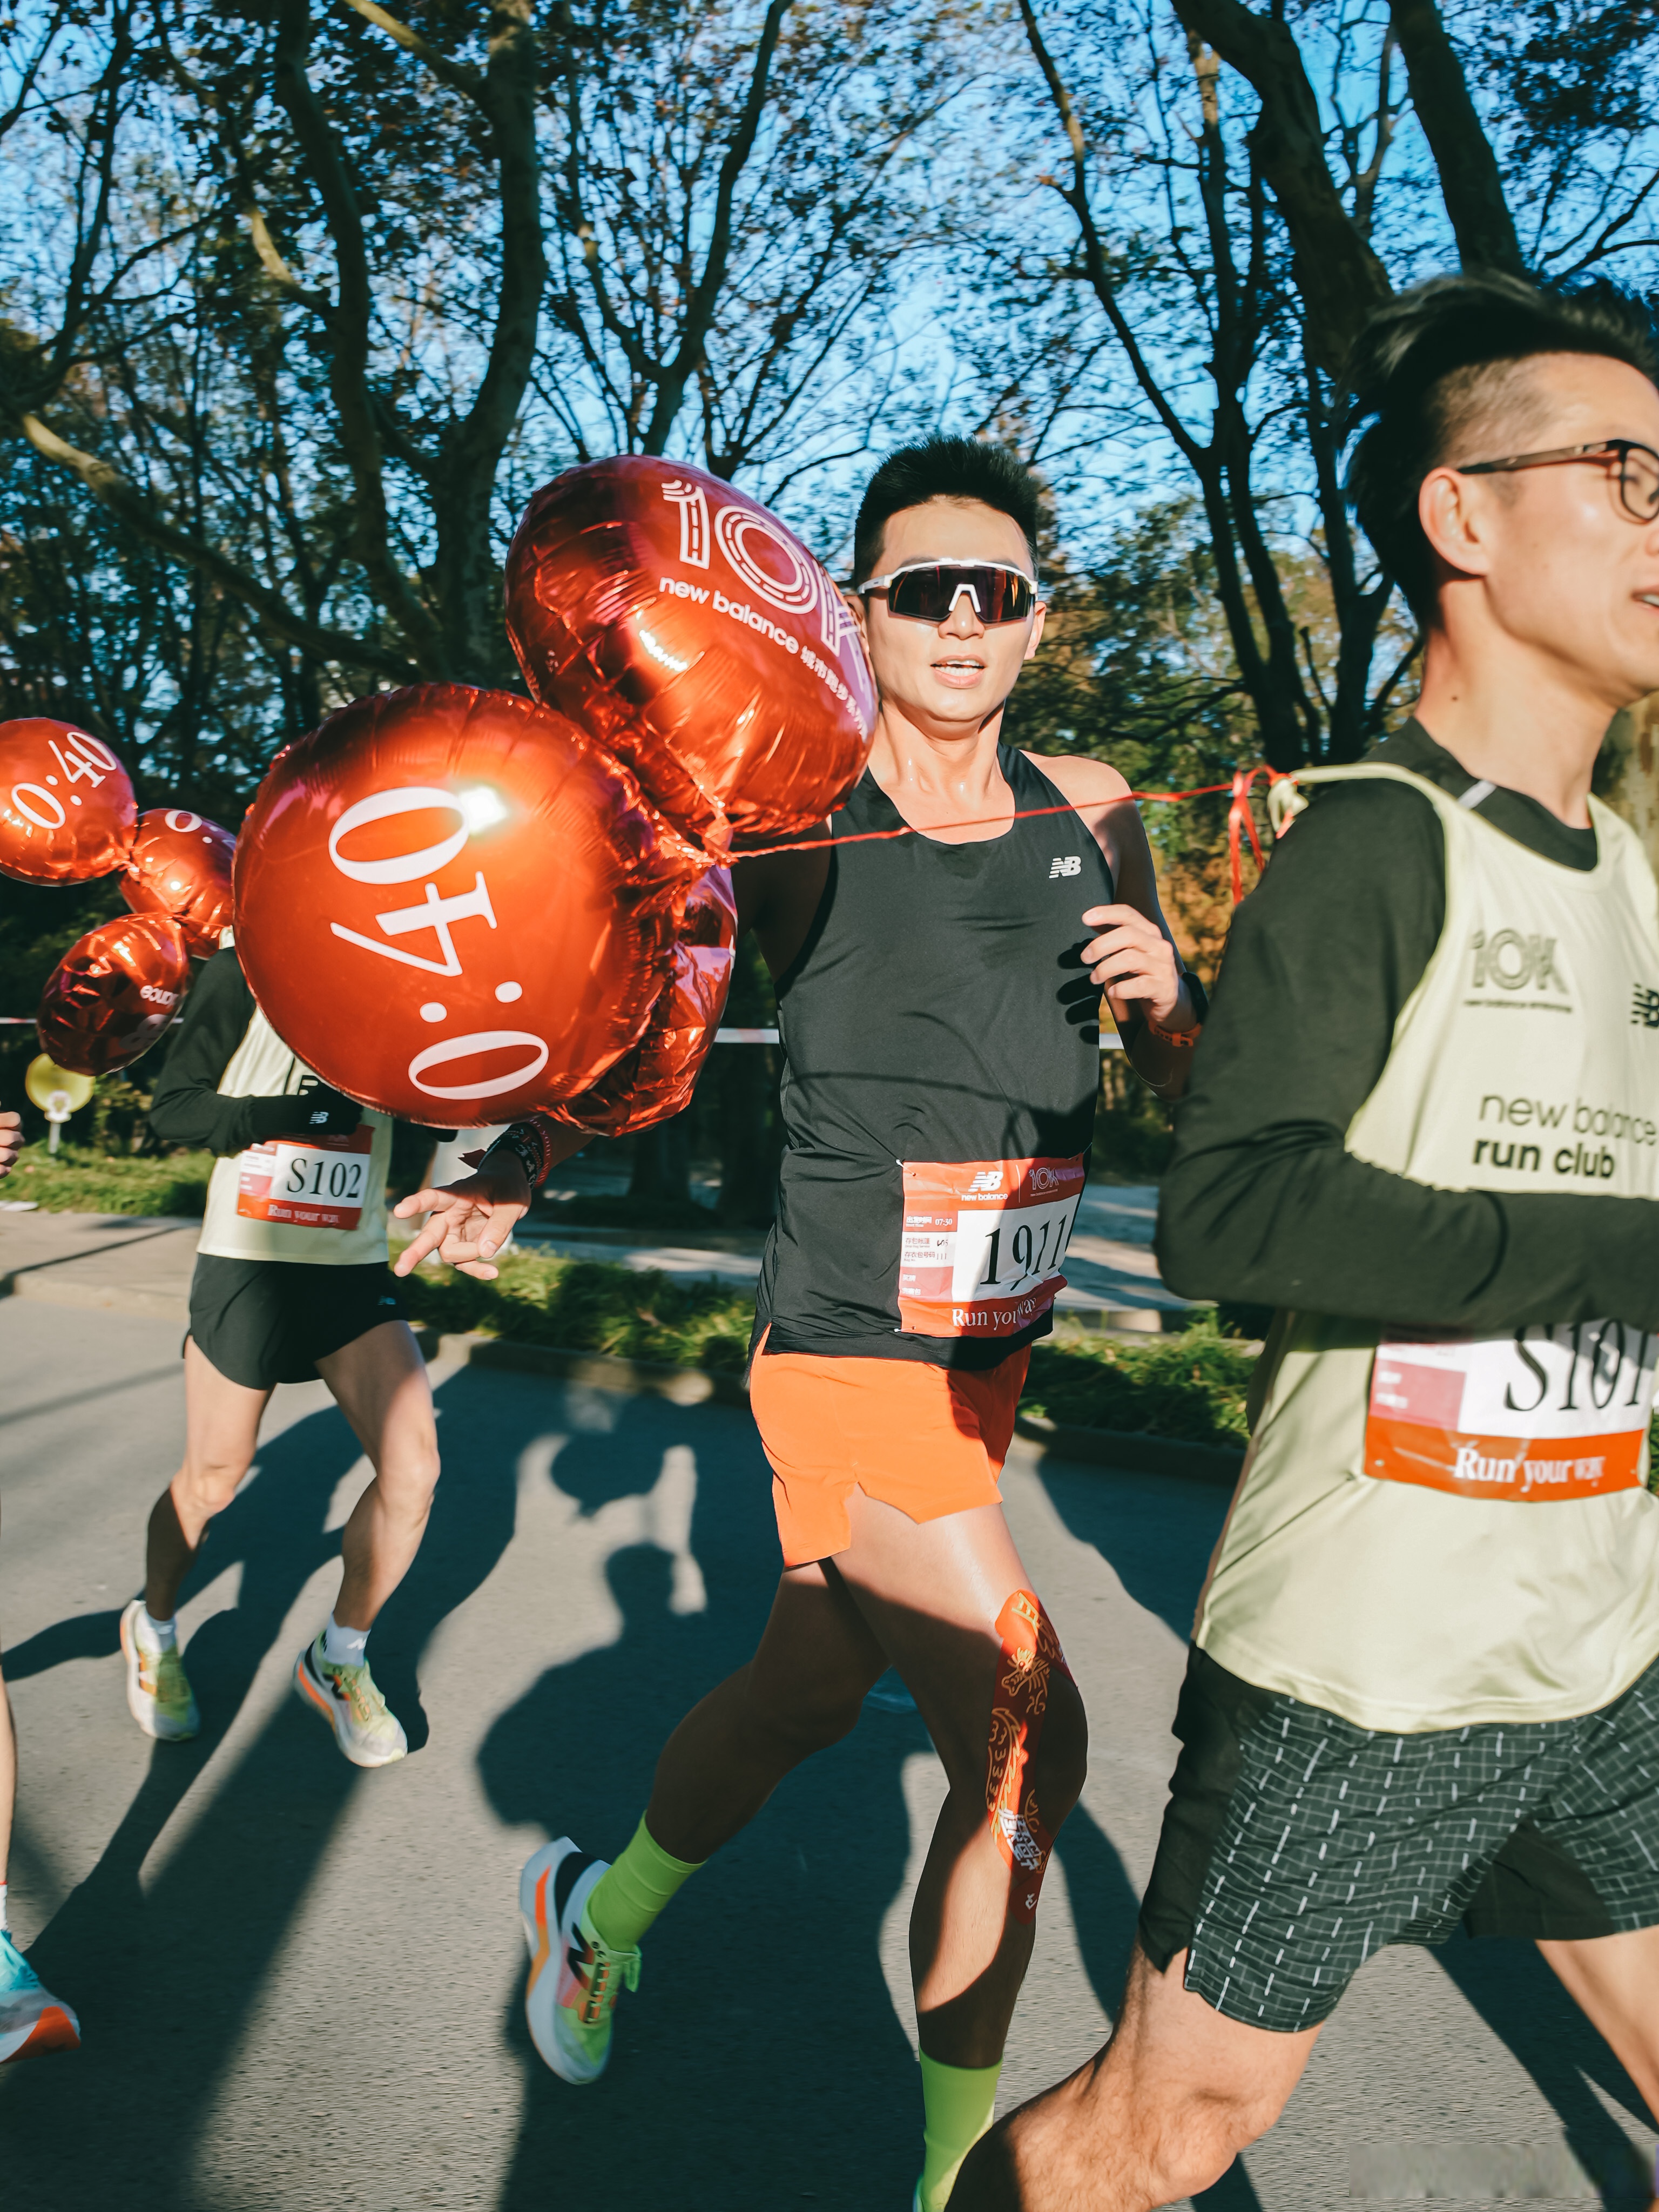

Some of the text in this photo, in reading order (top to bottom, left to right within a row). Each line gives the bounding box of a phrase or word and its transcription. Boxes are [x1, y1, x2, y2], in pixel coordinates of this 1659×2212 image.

[659, 576, 799, 654] new balance
[11, 731, 117, 824] 0:40
[1048, 855, 1082, 879] NB
[328, 786, 549, 1100] 0:40
[1469, 927, 1570, 995] 10K
[1479, 1094, 1568, 1129] new
[287, 1158, 362, 1199] S102
[1028, 1167, 1060, 1191] 10K
[1472, 1138, 1615, 1179] run club
[961, 1192, 1008, 1202] new balance
[967, 1171, 1004, 1193] NB
[935, 1218, 953, 1226] 07:30
[980, 1214, 1067, 1291] 1911
[952, 1308, 988, 1327] Run
[1503, 1318, 1649, 1411] S101
[1453, 1446, 1518, 1483] Run
[1520, 1459, 1573, 1493] your
